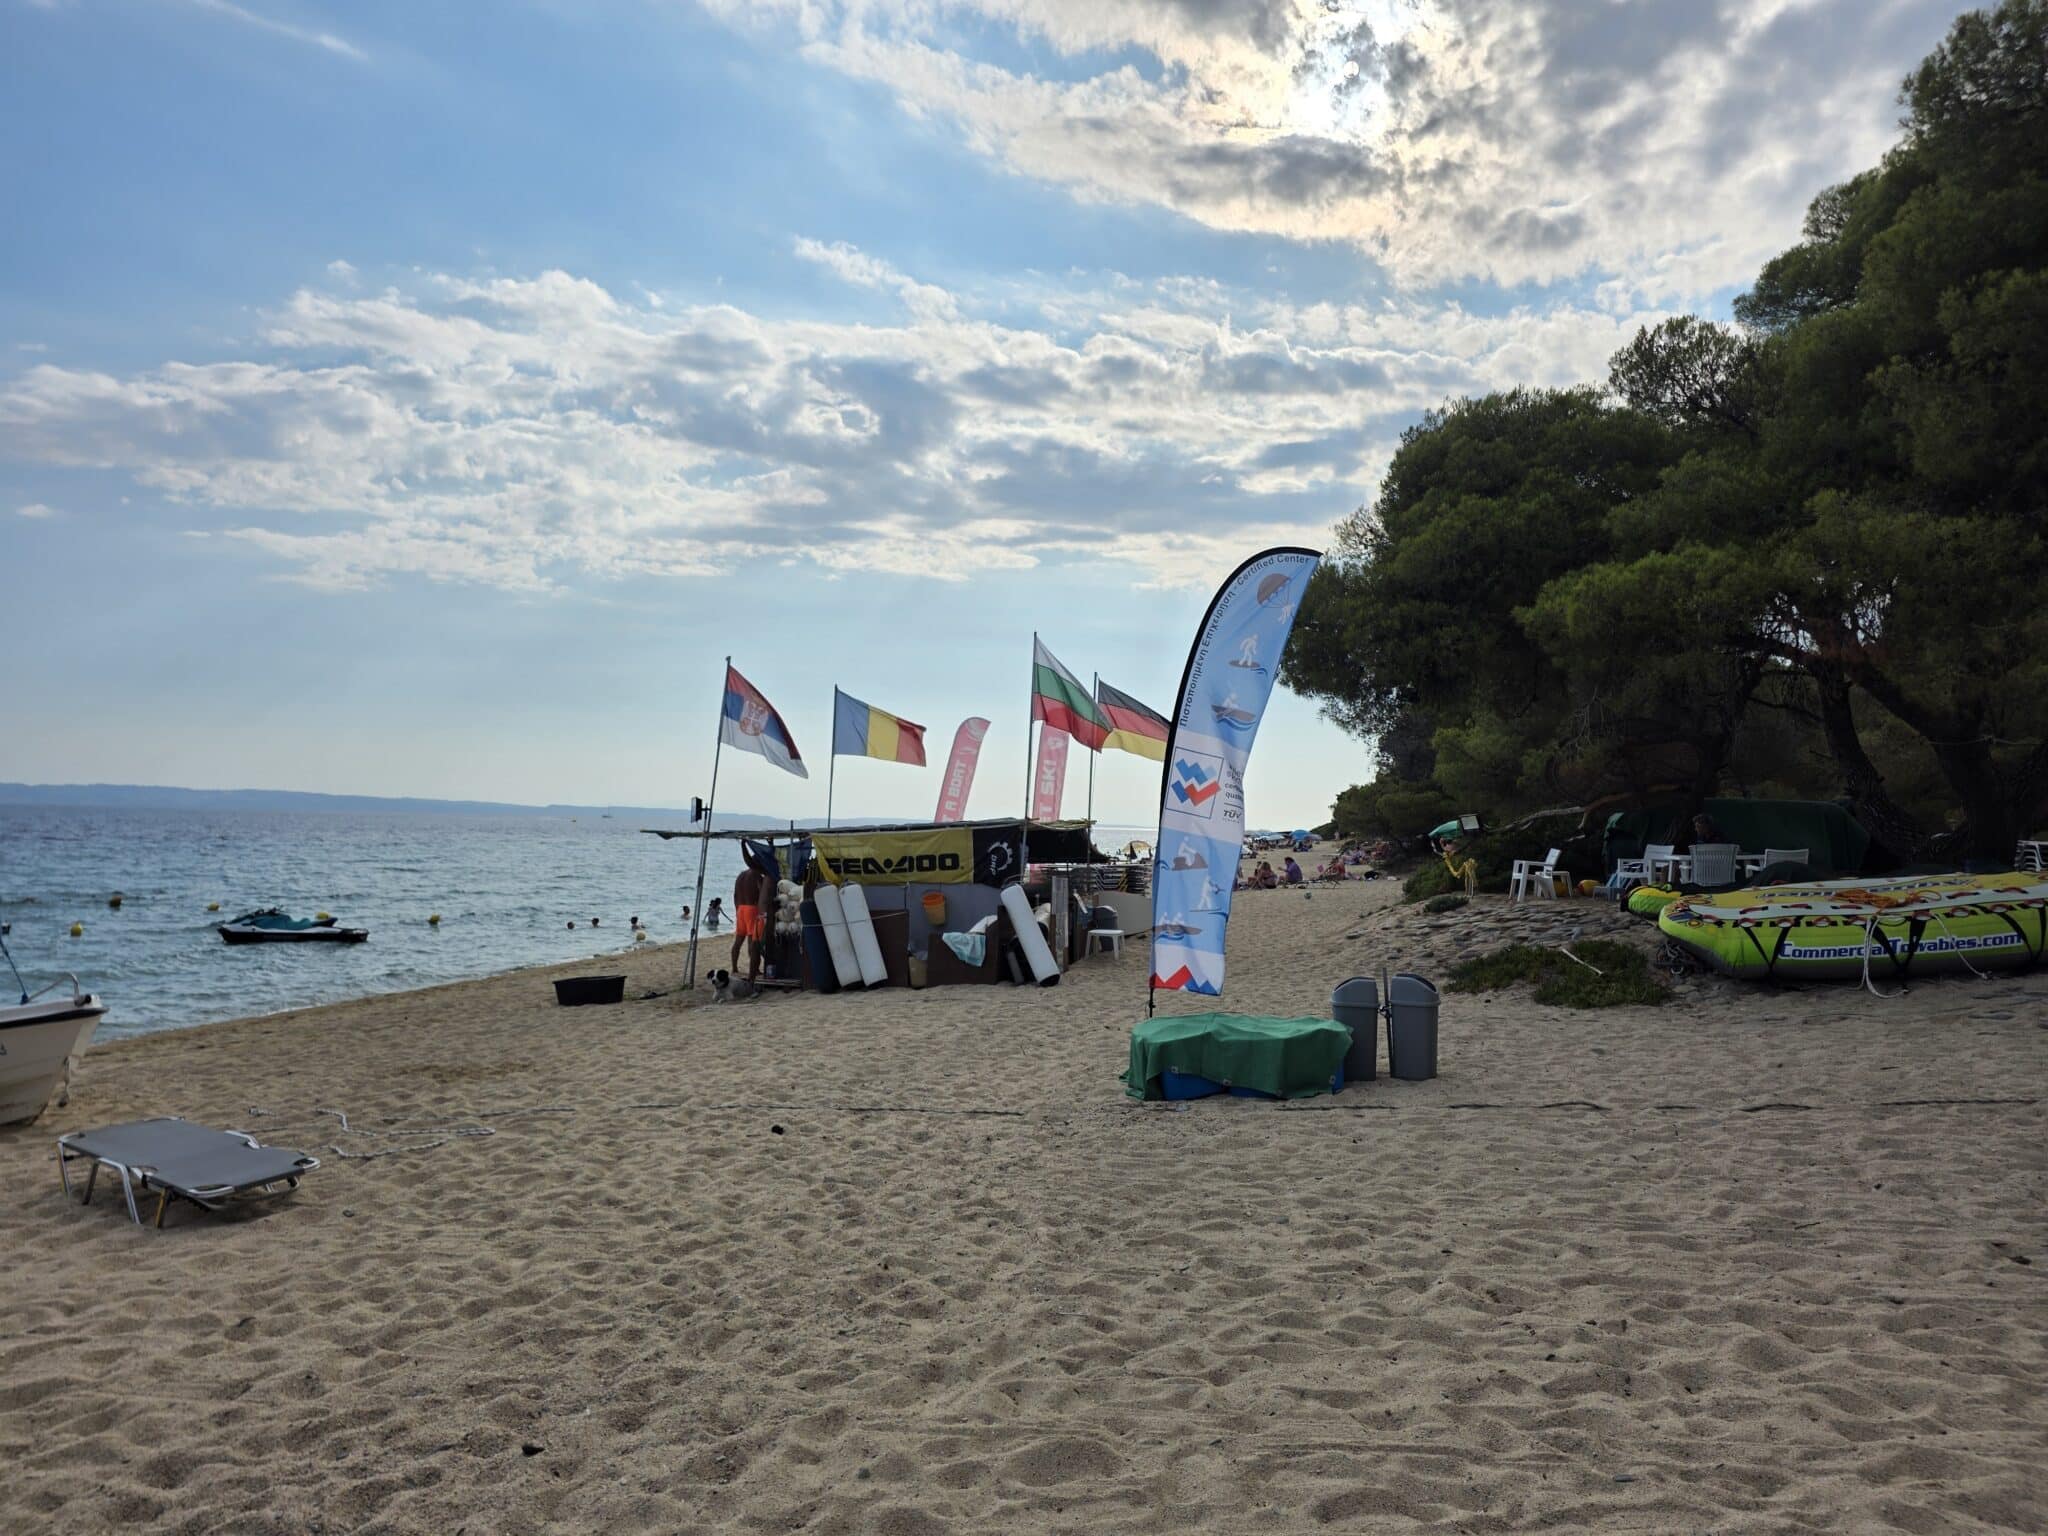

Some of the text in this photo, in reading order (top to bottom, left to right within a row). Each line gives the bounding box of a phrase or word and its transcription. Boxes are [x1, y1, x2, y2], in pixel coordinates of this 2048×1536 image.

[1236, 557, 1280, 586] Certified
[1276, 554, 1310, 564] Center
[947, 759, 967, 798] BOAT
[1041, 759, 1056, 795] SKI
[1779, 933, 2023, 959] CommercalTowables.com
